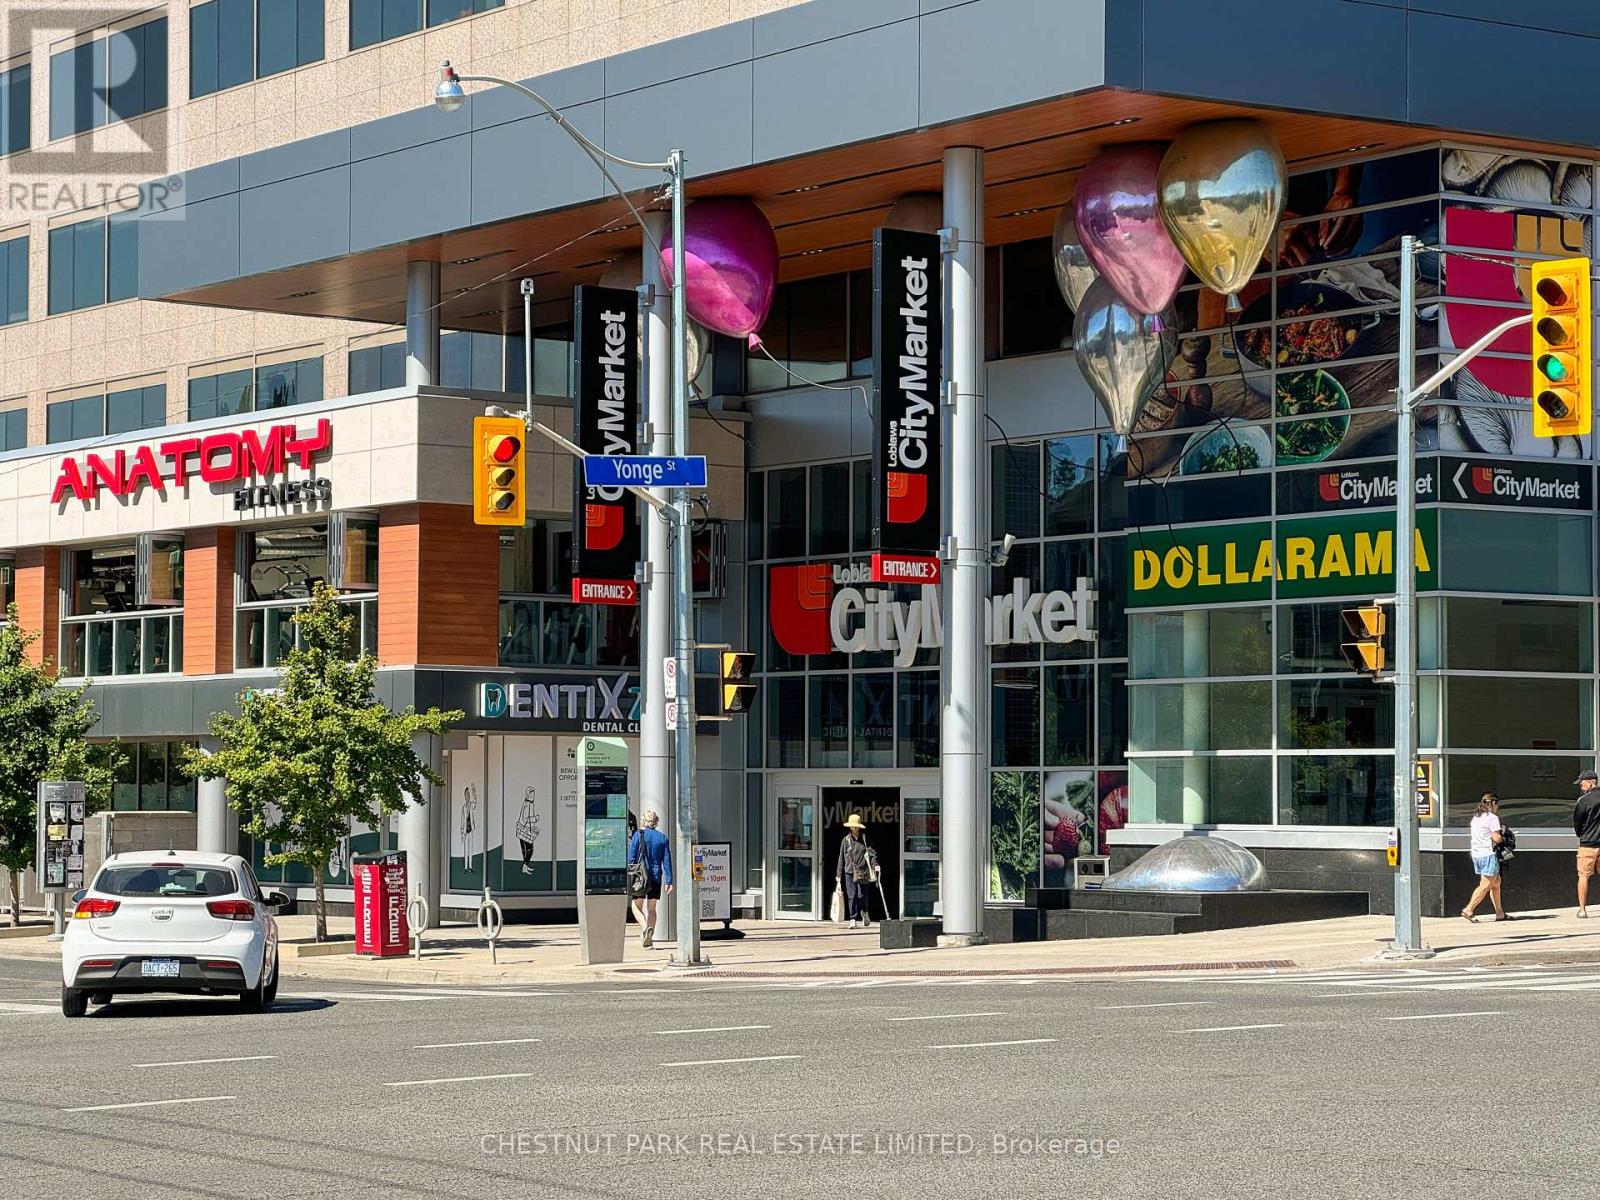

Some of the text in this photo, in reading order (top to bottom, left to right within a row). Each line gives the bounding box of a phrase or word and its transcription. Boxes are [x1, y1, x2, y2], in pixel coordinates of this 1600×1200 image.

[899, 255, 935, 468] CityMarket
[887, 420, 898, 467] Loblaws
[51, 418, 331, 503] ANATOMY
[612, 459, 676, 485] Yonge St
[233, 477, 332, 511] FITNESS
[1340, 473, 1433, 505] CityMaet
[1493, 474, 1580, 501] CityMarket
[833, 562, 873, 584] Lobla
[882, 560, 929, 578] ENTRANCE
[582, 583, 625, 599] ENTRANCE
[830, 576, 1099, 668] CityMrket
[583, 721, 624, 733] DENTAL
[708, 864, 724, 872] Open
[363, 896, 371, 943] FREE
[388, 896, 400, 943] FREE
